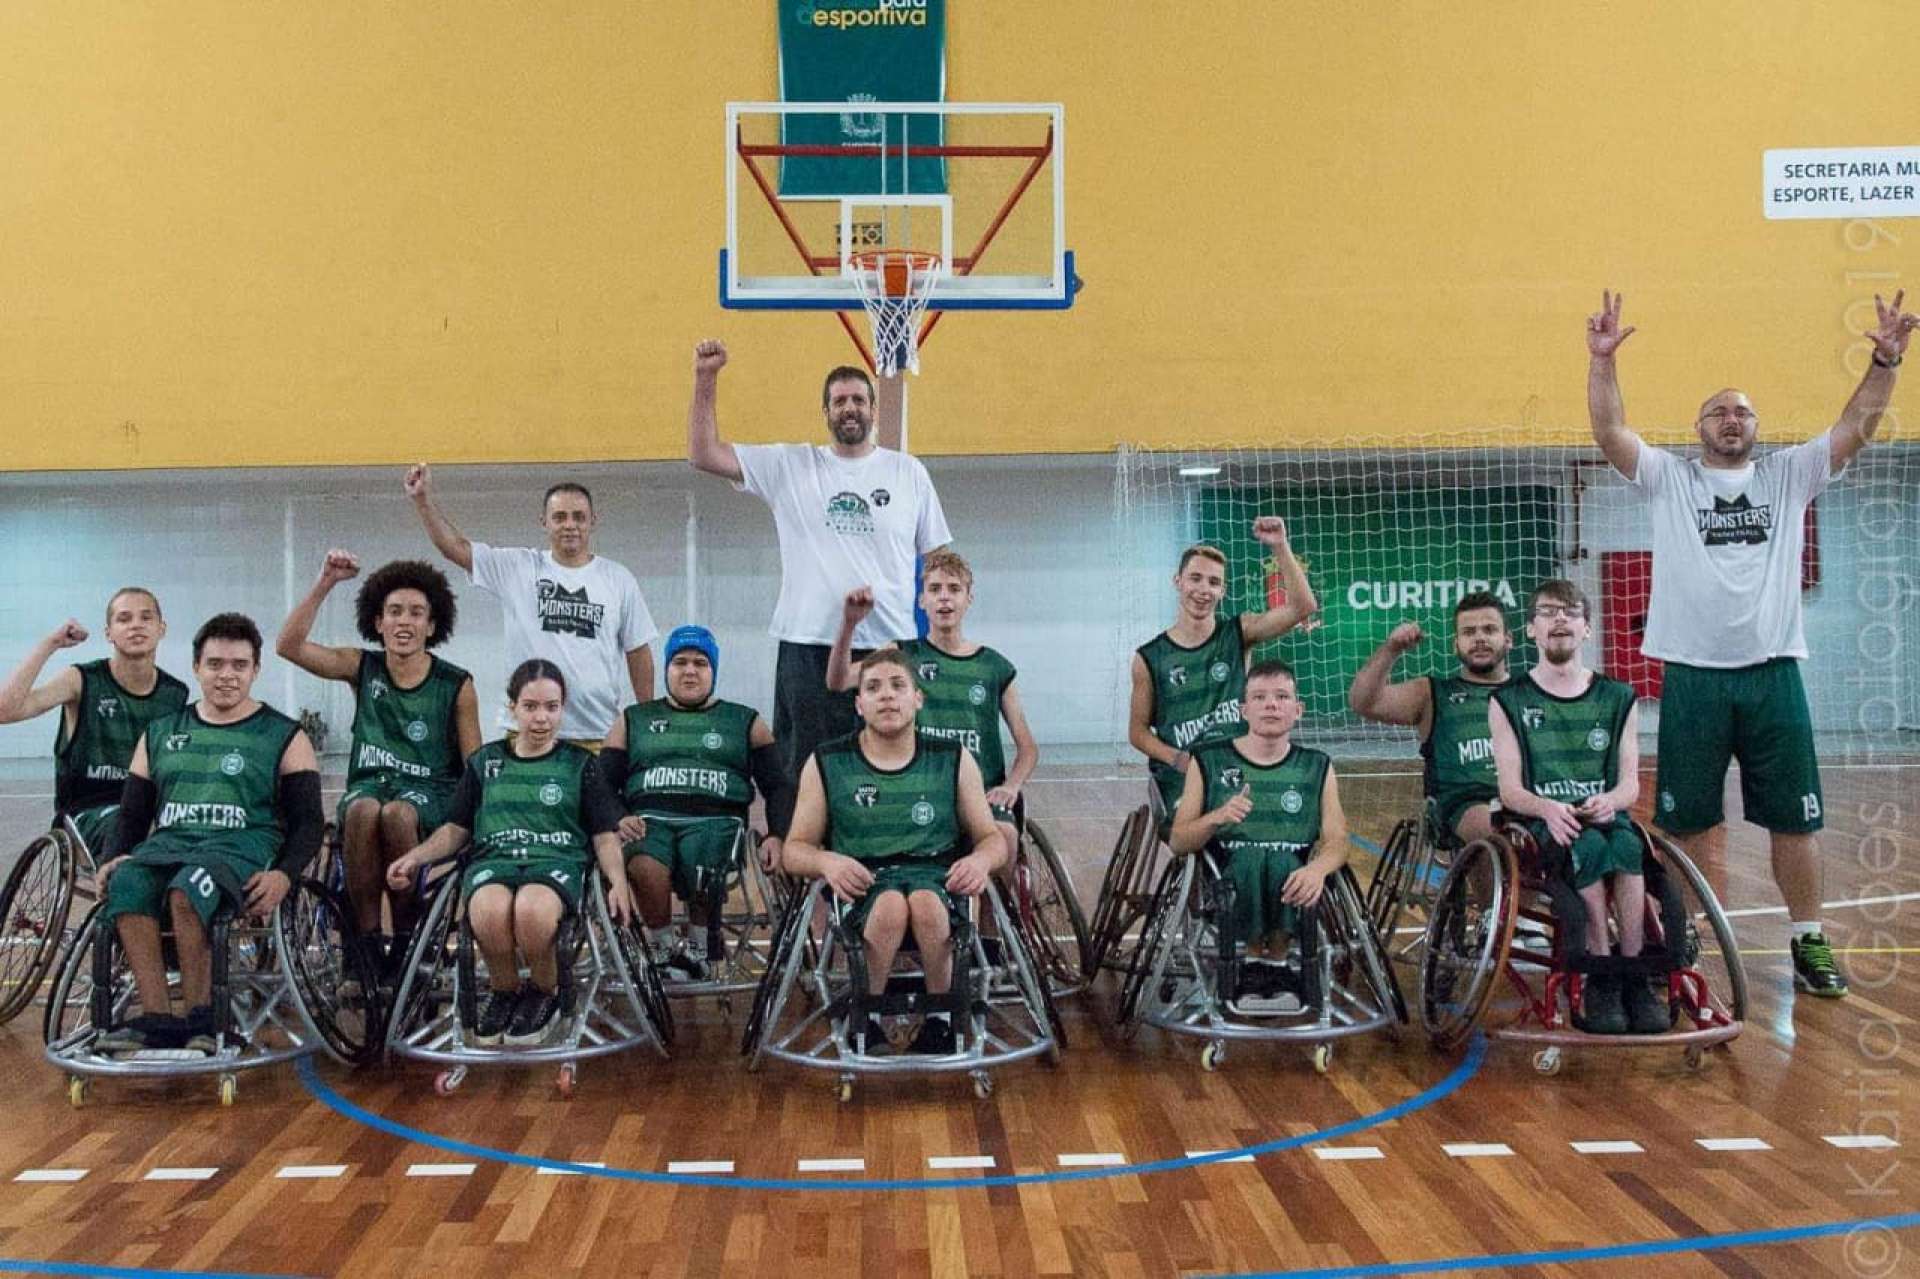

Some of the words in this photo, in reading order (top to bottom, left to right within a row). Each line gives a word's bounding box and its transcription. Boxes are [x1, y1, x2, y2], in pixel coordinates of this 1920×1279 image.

[1784, 162, 1890, 178] SECRETARIA
[1773, 187, 1855, 203] ESPORTE,
[1860, 186, 1914, 200] LAZER
[1698, 507, 1769, 529] MONSTERS
[539, 599, 602, 623] MONSTERS
[1457, 738, 1494, 764] MON
[643, 766, 728, 797] MONSTERS
[158, 802, 247, 828] ONSTERS
[1801, 793, 1821, 821] 19
